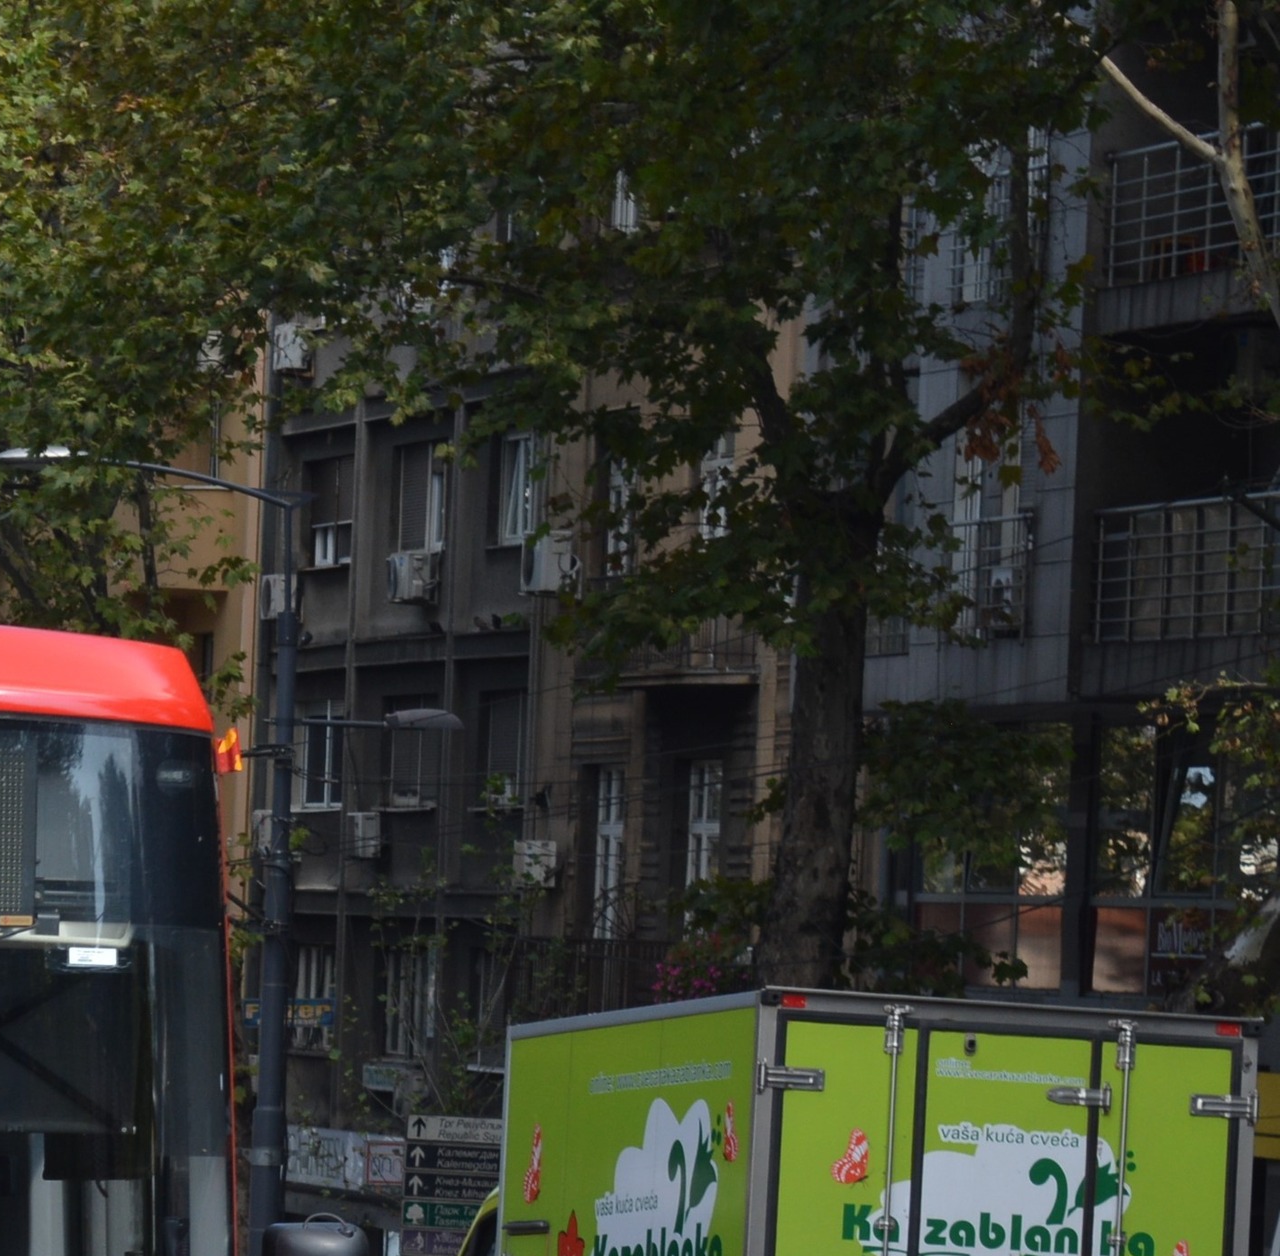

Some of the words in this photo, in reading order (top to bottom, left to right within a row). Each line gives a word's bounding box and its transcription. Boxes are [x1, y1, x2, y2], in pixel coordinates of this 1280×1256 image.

[940, 1124, 980, 1142] vaša
[985, 1126, 1025, 1145] kuća
[1029, 1128, 1080, 1148] cveća
[436, 1158, 498, 1172] Kalemegdan
[596, 1194, 614, 1217] vaša
[615, 1193, 634, 1215] kuća
[634, 1191, 659, 1212] cveća
